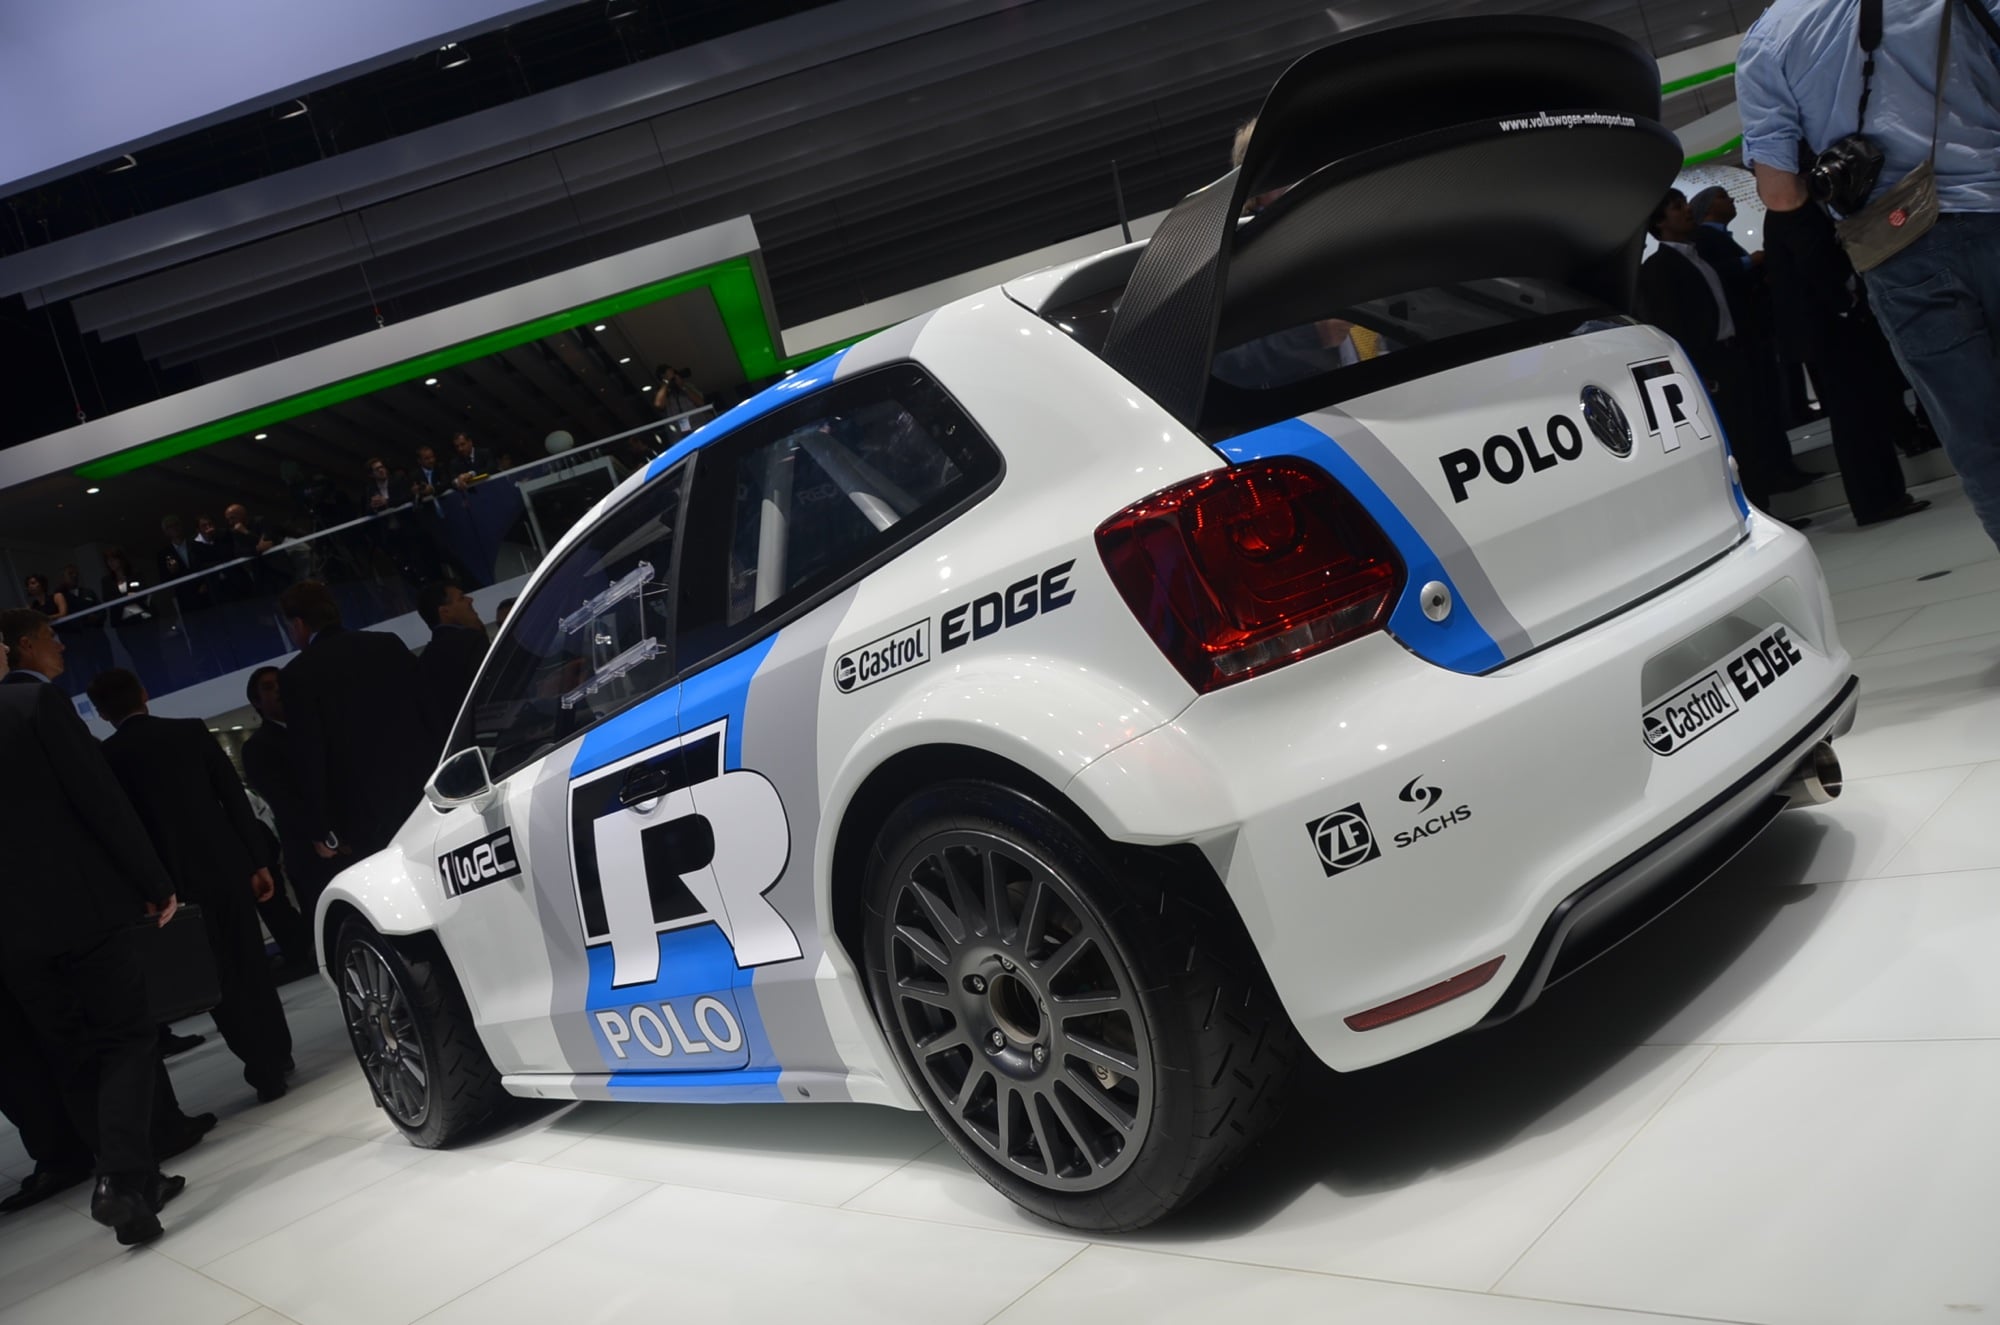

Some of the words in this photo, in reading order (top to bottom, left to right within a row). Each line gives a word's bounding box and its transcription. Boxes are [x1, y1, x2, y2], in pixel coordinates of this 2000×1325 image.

[1499, 111, 1636, 132] www.volkswagen-motorsport.com
[1642, 369, 1712, 454] R
[1439, 414, 1583, 503] POLO
[859, 628, 923, 681] Castrol
[941, 558, 1077, 654] EDGE
[1665, 681, 1730, 739] Castrol
[1726, 626, 1802, 702] EDGE
[1317, 816, 1370, 862] ZF
[1393, 804, 1472, 848] SACHS
[590, 766, 804, 988] R
[595, 996, 742, 1059] POLO
